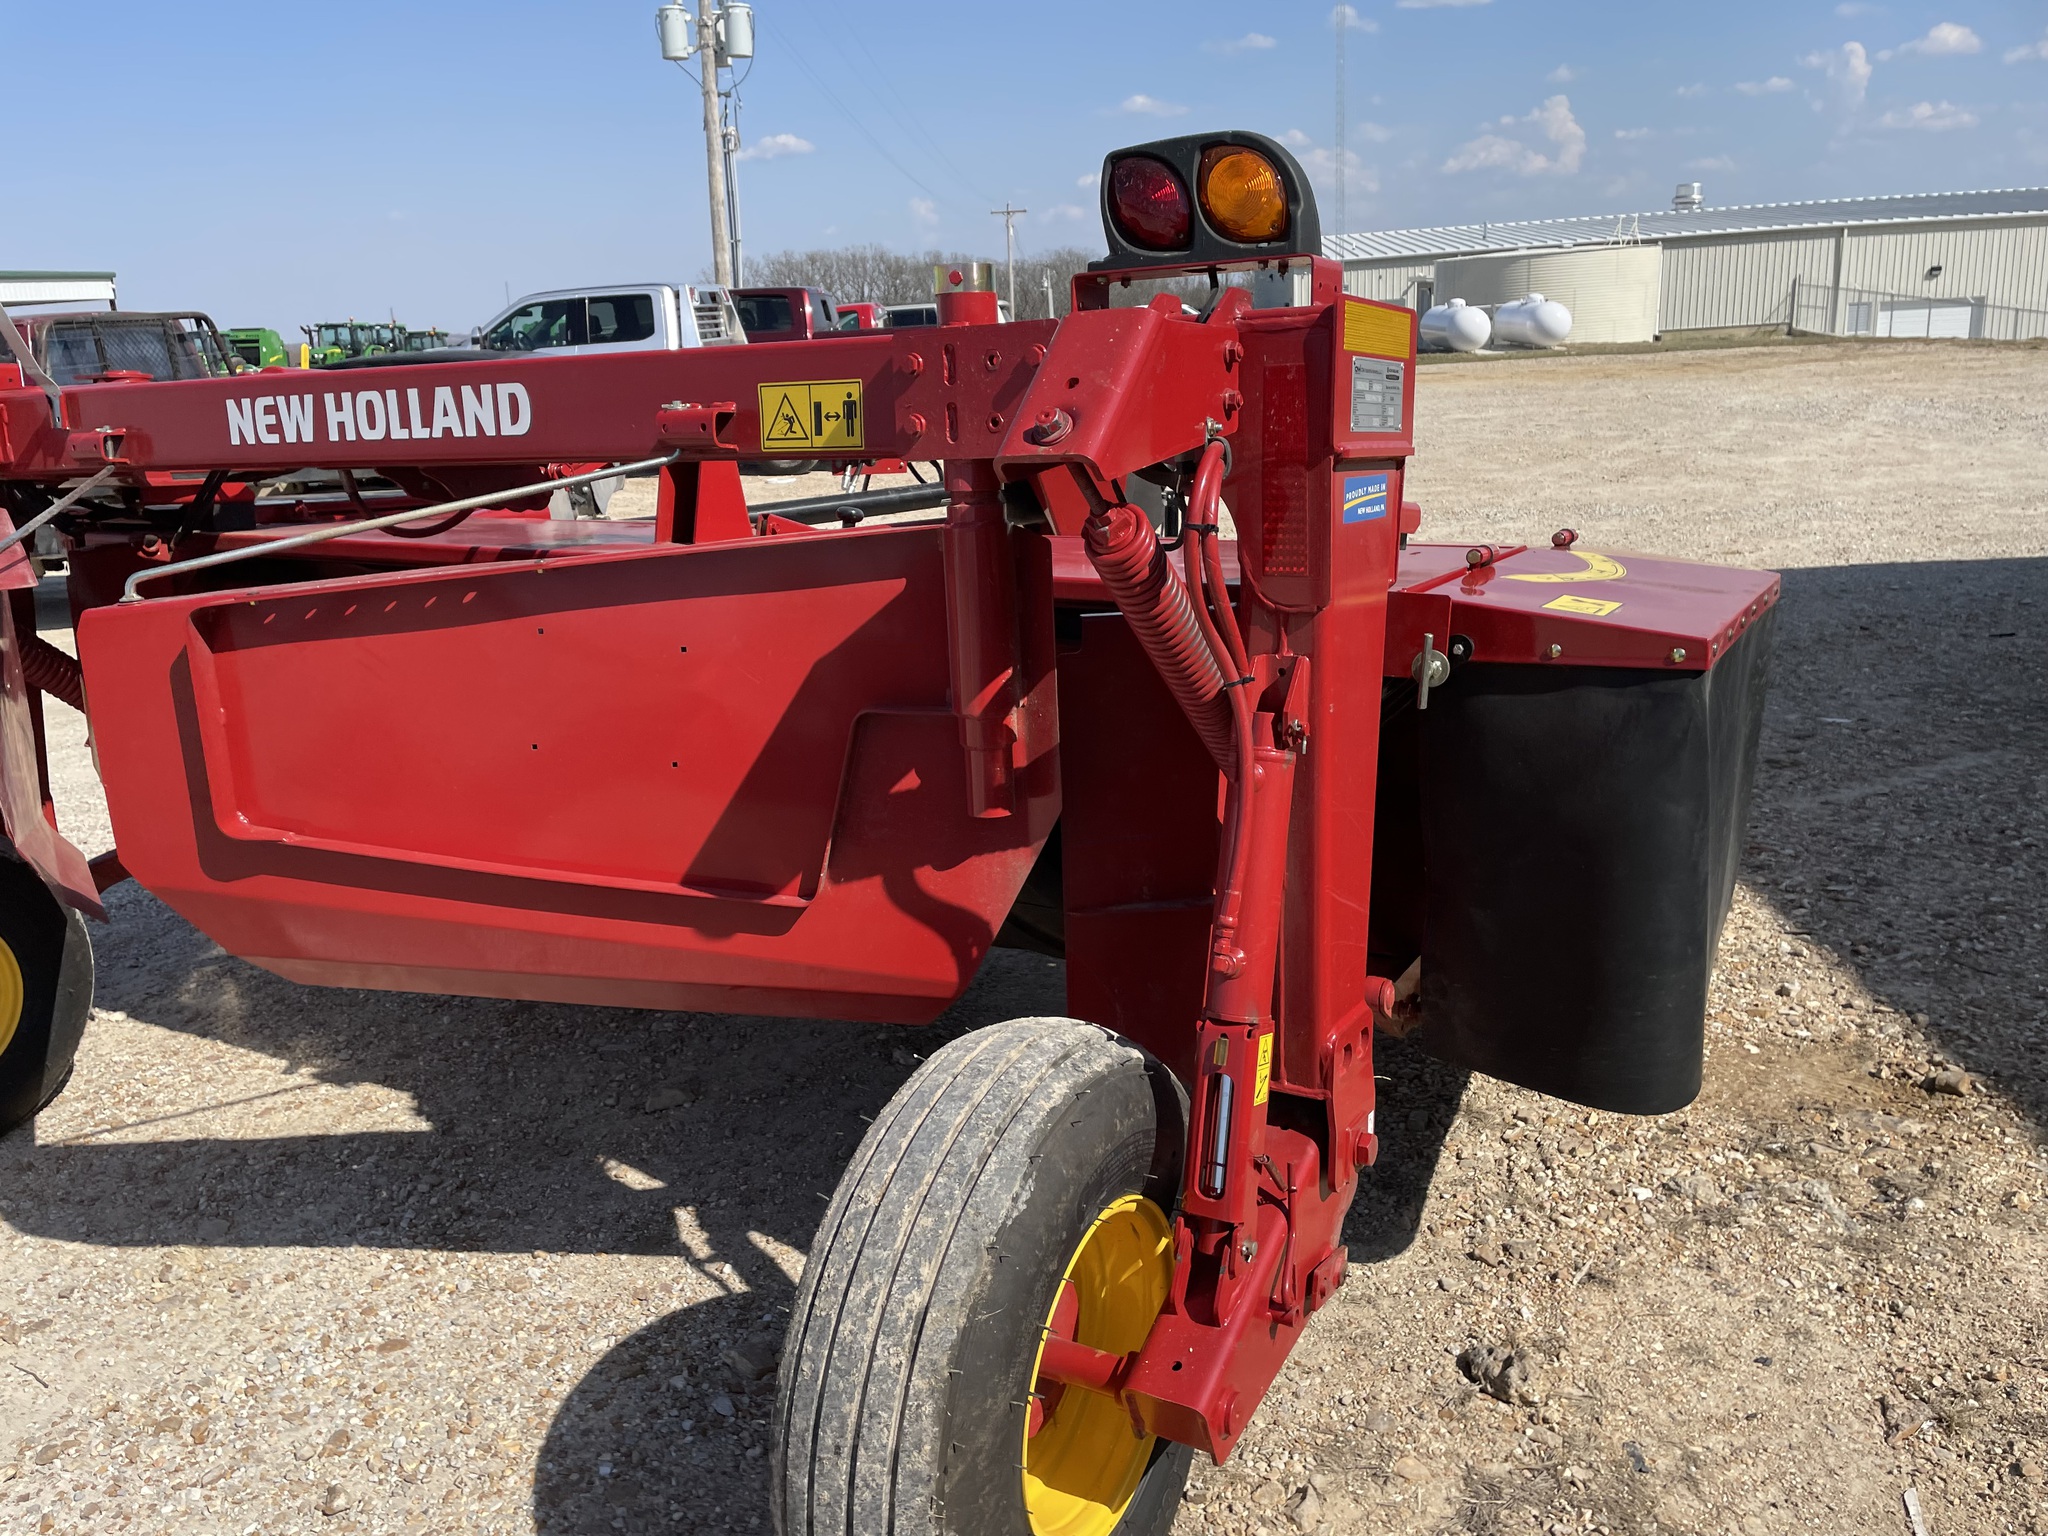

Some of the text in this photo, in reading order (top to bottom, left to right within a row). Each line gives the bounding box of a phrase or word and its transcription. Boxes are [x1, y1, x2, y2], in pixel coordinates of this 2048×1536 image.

[226, 382, 531, 445] NEW HOLLAND
[1346, 483, 1386, 501] PROUDLY MADE IN
